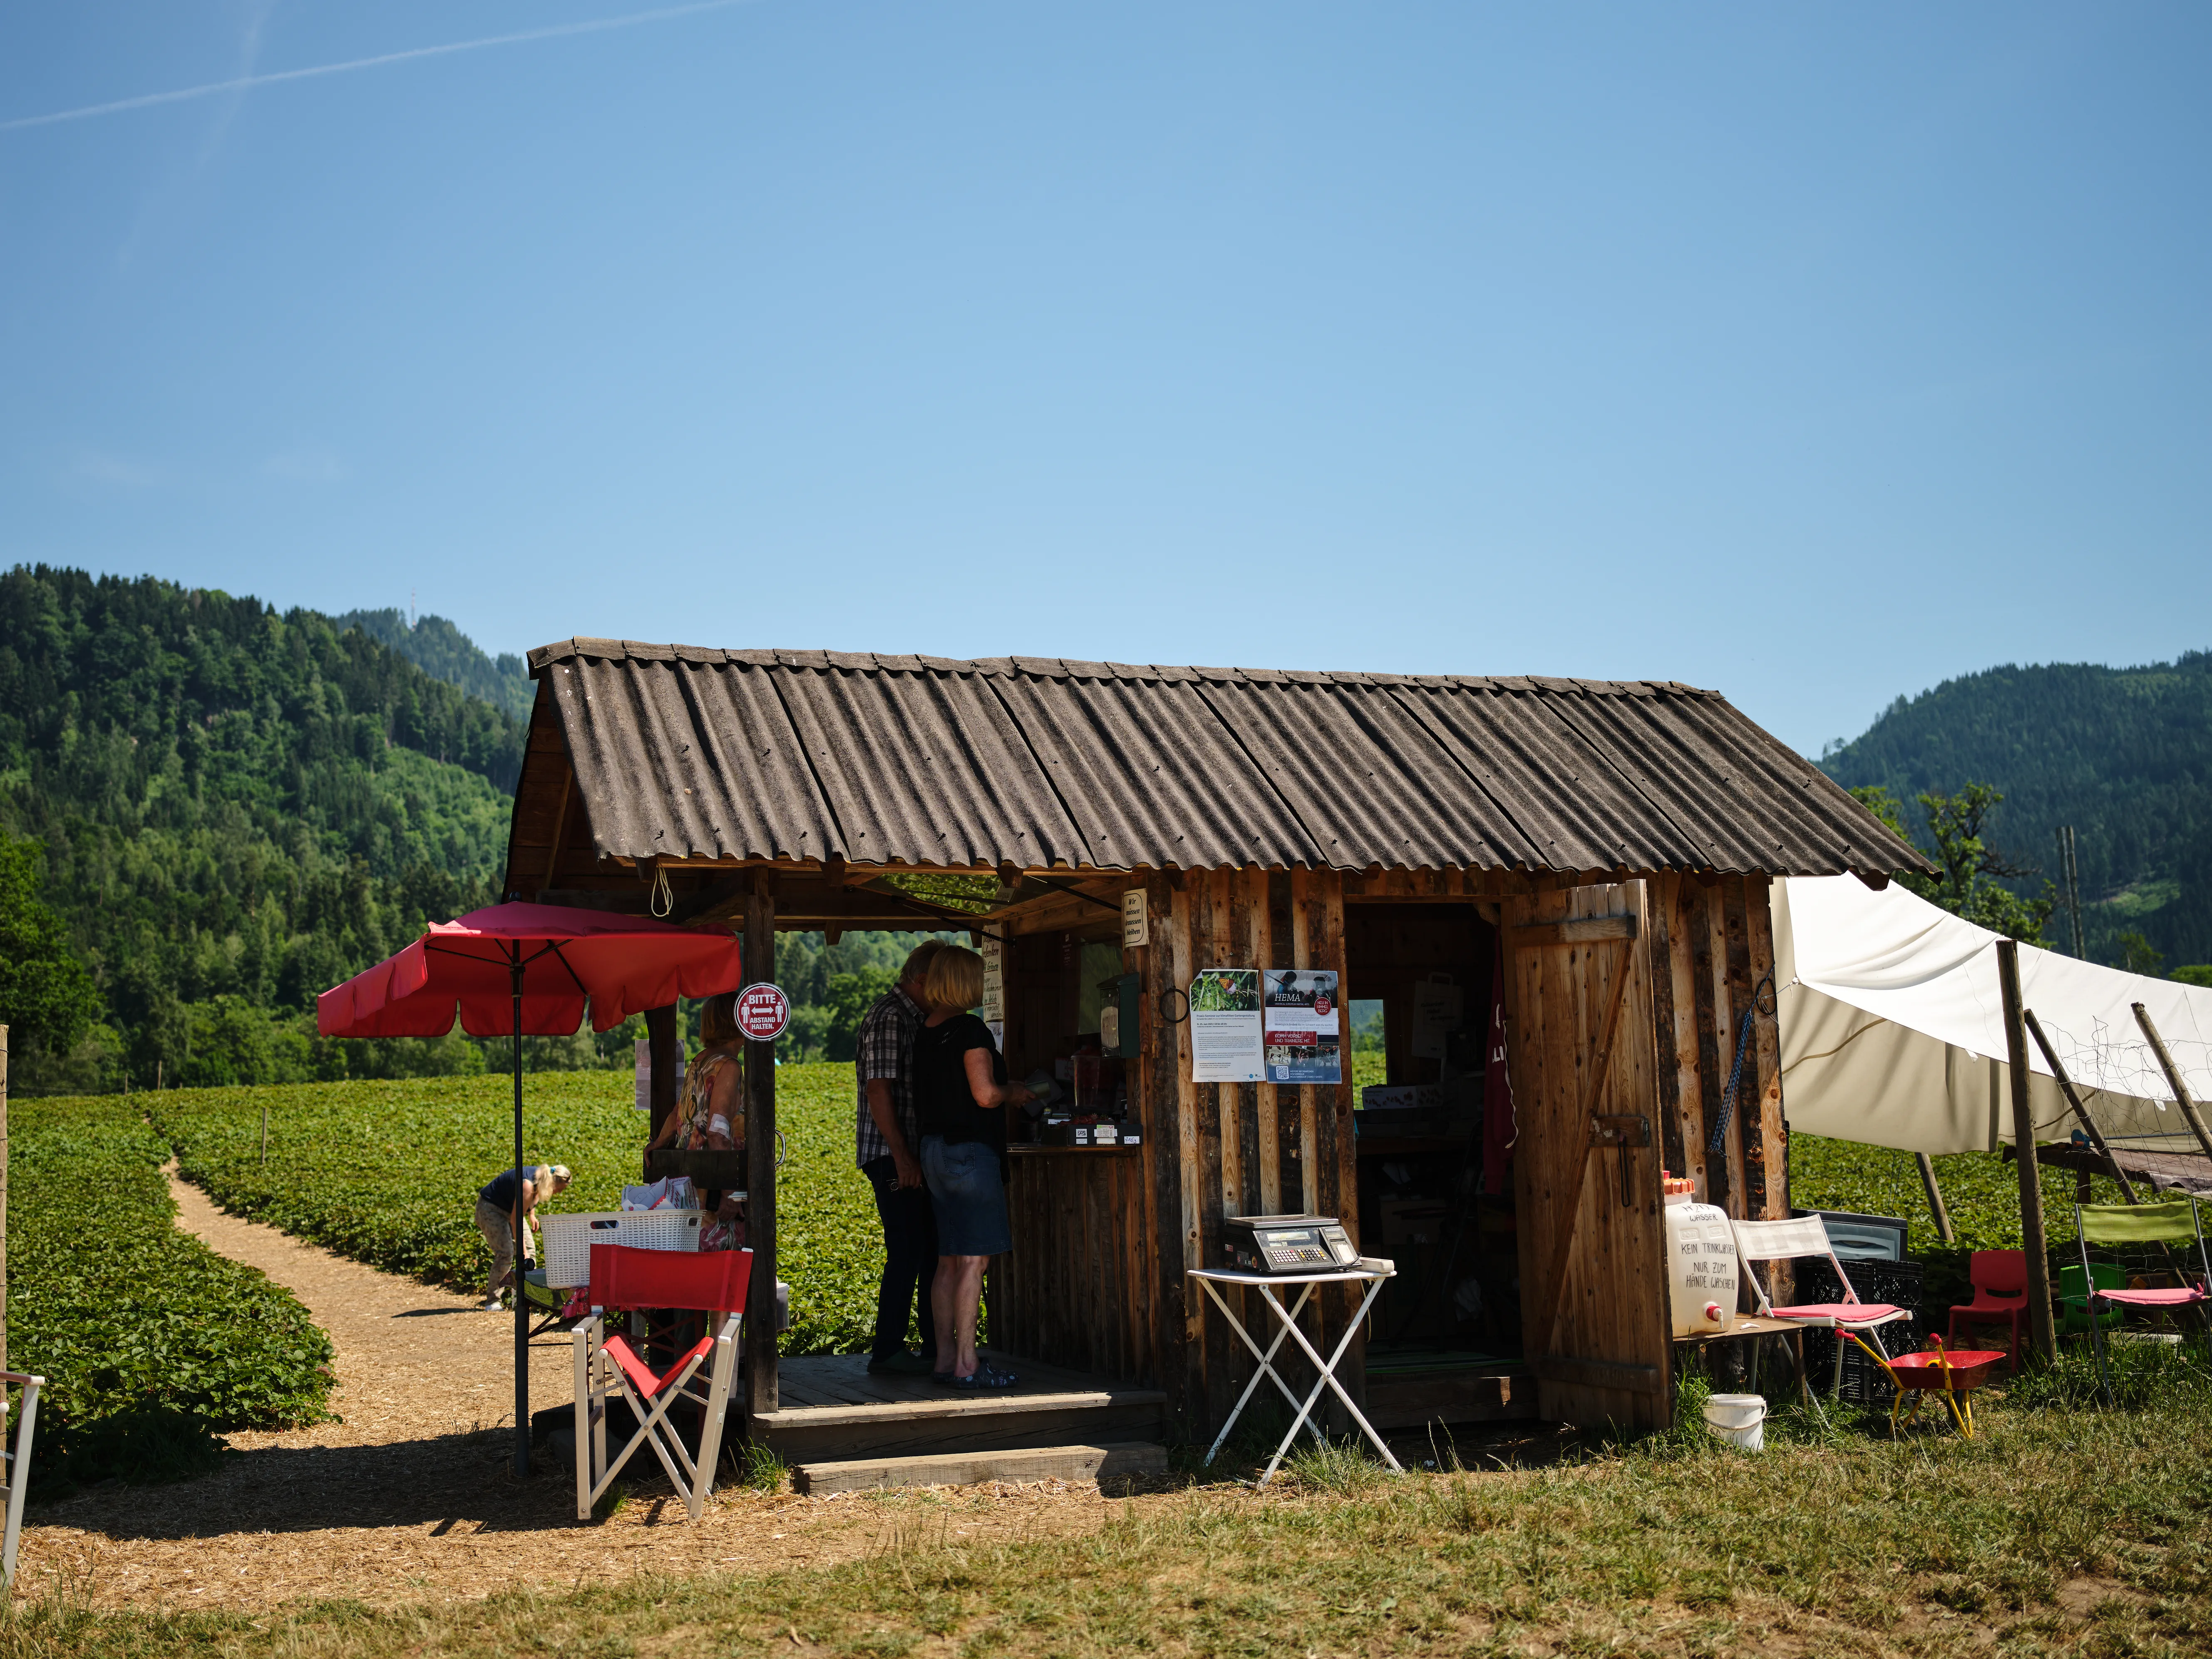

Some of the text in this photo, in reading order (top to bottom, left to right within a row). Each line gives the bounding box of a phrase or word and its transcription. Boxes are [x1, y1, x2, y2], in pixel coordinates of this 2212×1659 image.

[749, 994, 776, 1004] BITTE
[1690, 1213, 1718, 1222] WASSER
[1681, 1243, 1735, 1255] KEIN TRINKWASSER
[1694, 1262, 1726, 1274] NUR ZUM
[1686, 1273, 1735, 1290] HÄNDE WASCHEN
